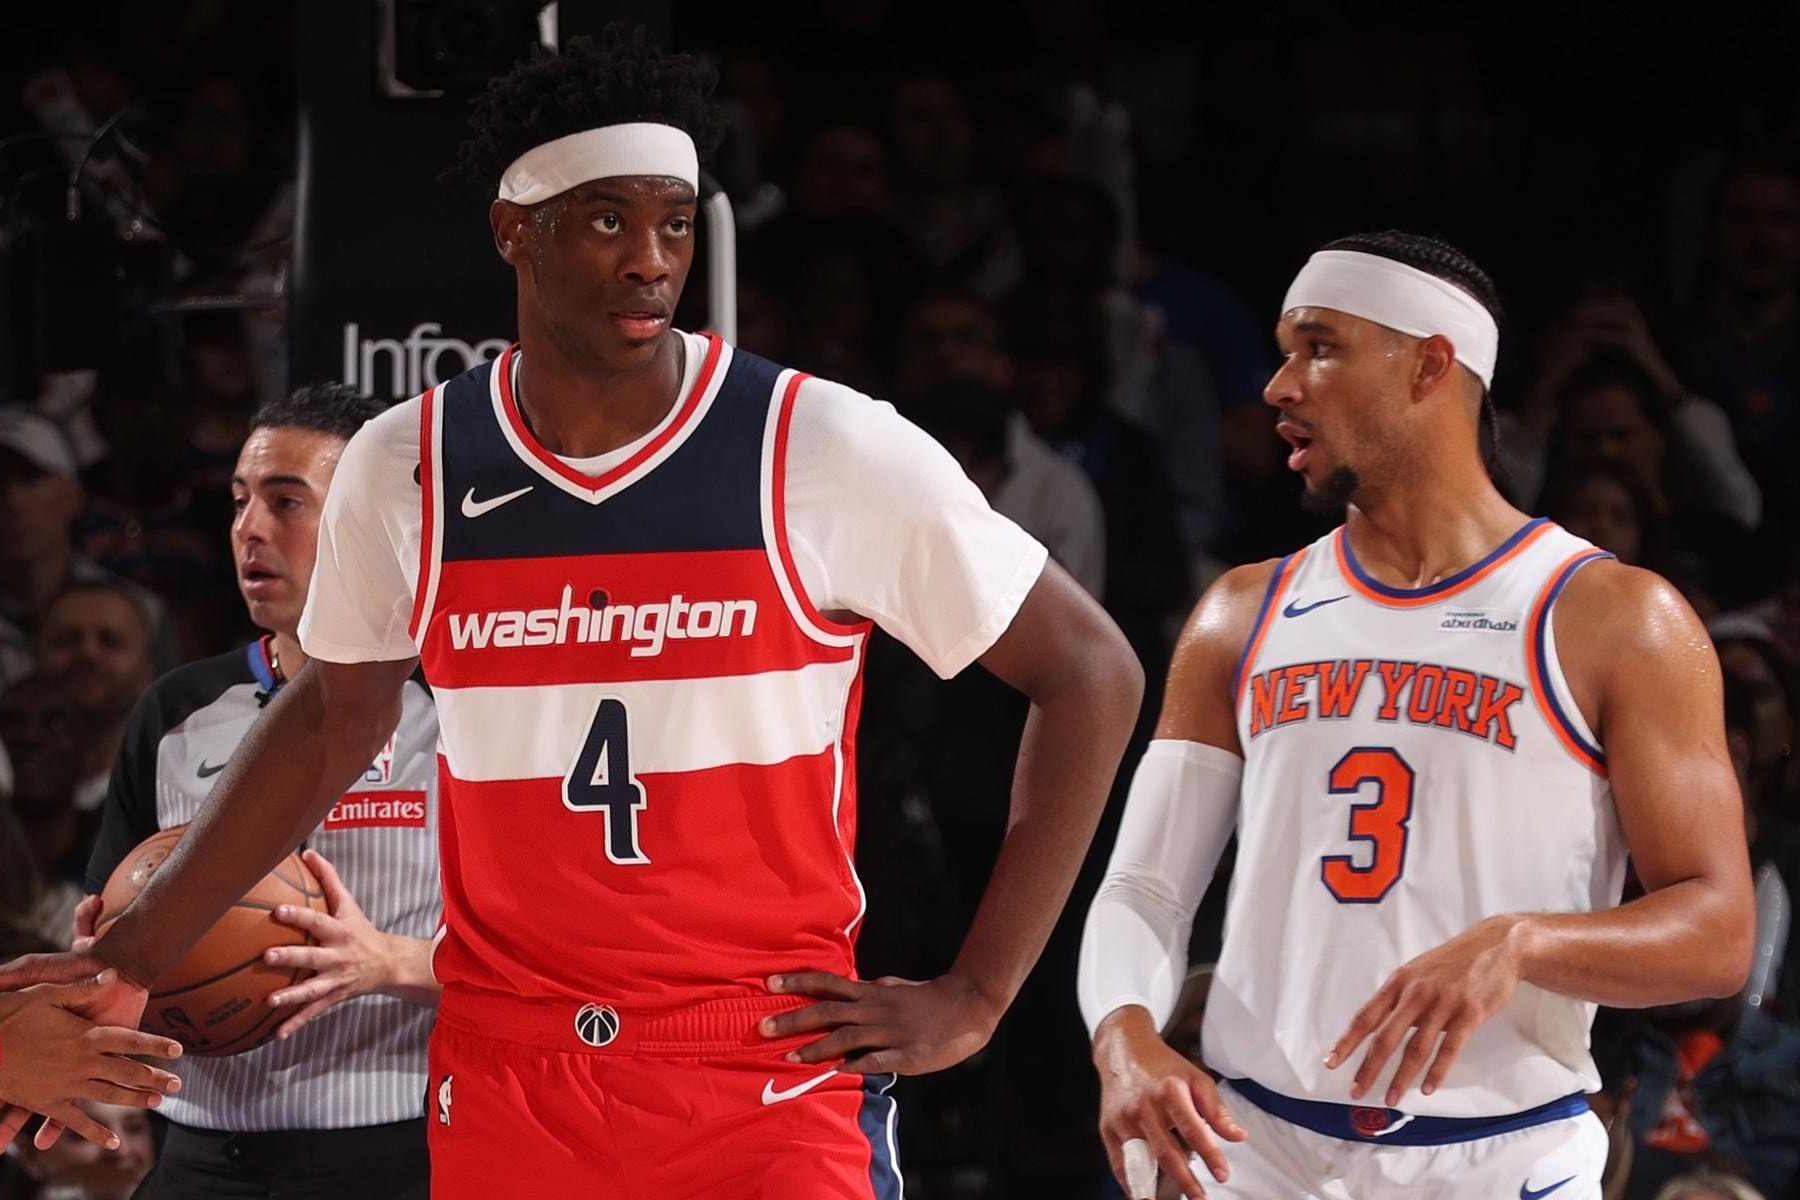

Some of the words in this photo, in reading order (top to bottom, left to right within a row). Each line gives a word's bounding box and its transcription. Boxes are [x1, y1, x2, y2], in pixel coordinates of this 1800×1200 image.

[449, 583, 757, 657] washington
[1250, 658, 1373, 738] NEW
[1376, 660, 1523, 752] YORK
[327, 798, 424, 821] Emirates
[561, 694, 651, 865] 4
[1320, 746, 1416, 903] 3
